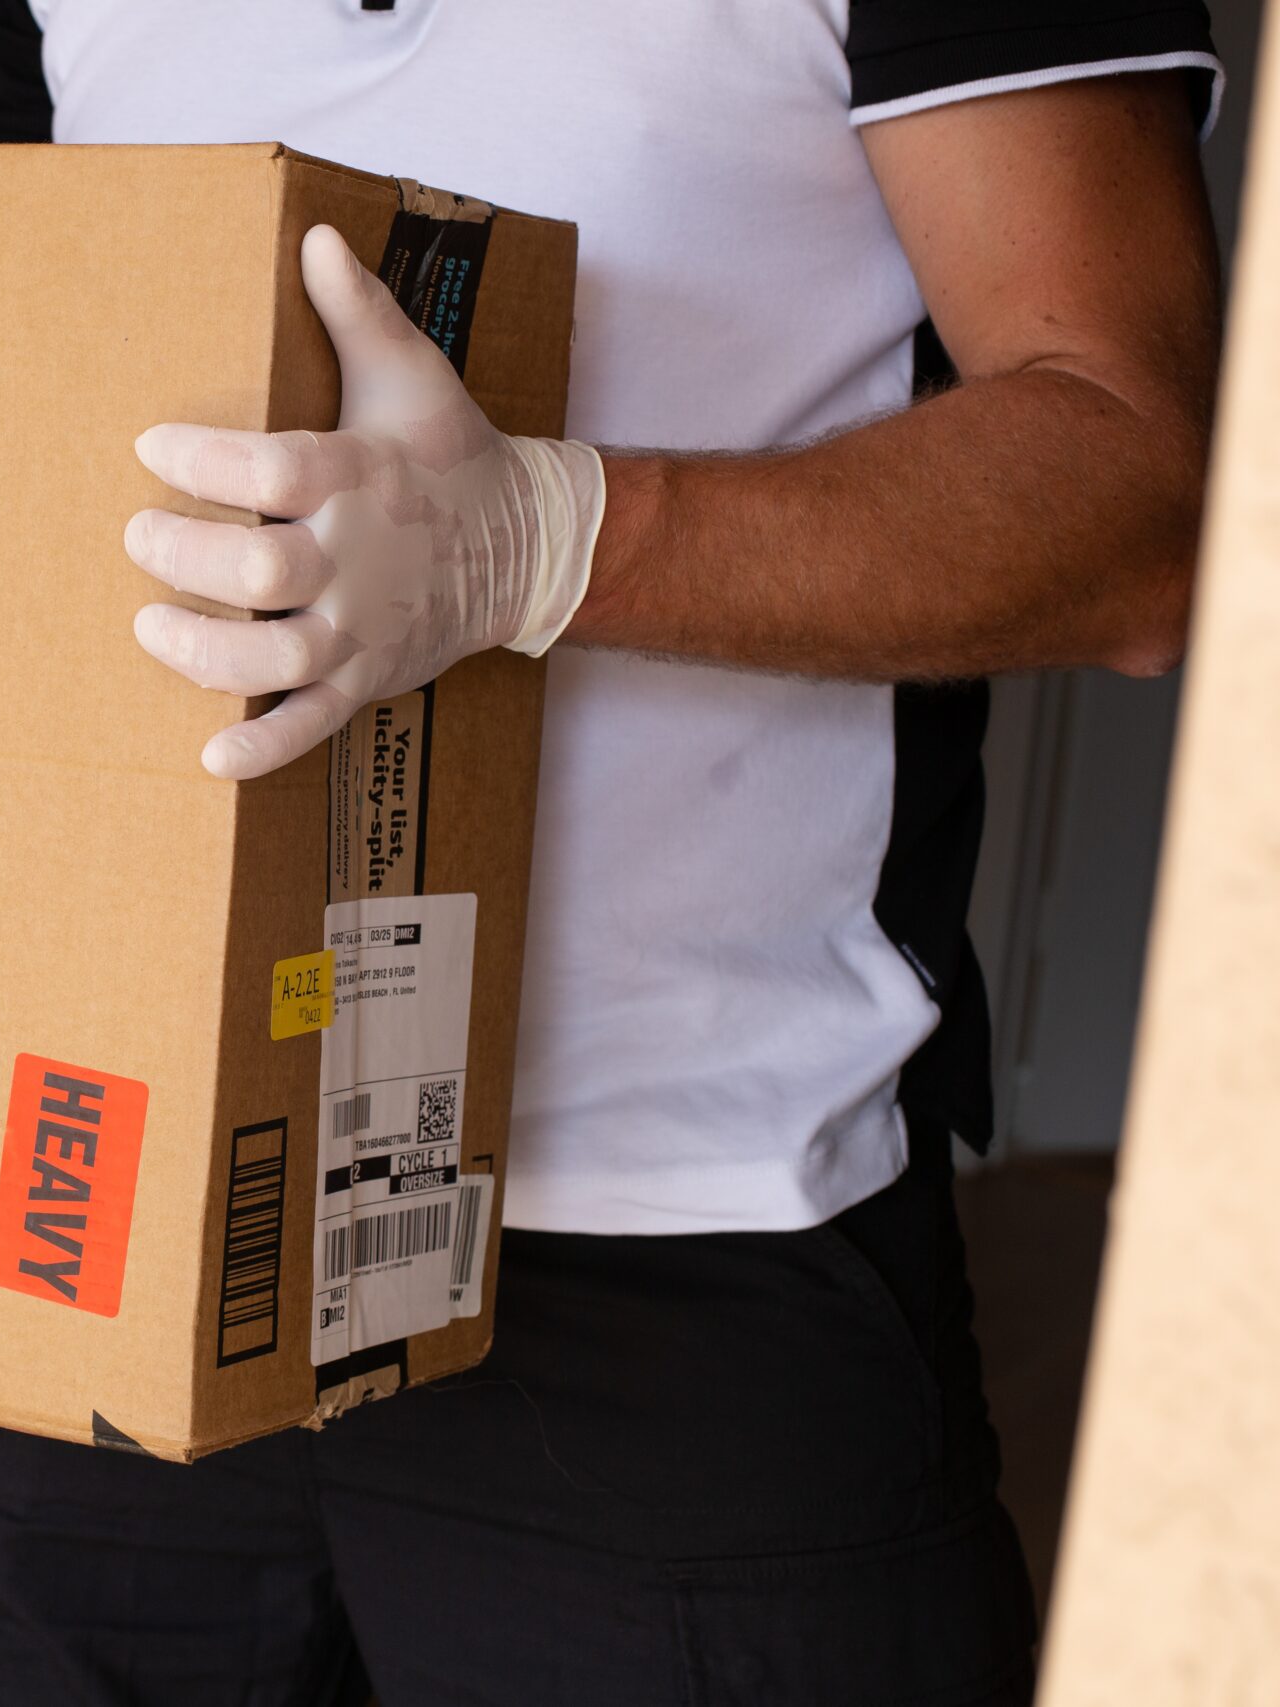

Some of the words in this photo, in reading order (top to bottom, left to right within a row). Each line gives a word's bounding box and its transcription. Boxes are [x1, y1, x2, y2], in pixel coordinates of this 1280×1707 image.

[430, 255, 443, 286] Now
[452, 258, 470, 304] Free
[430, 257, 457, 339] grocery
[392, 727, 411, 801] Your
[335, 729, 345, 876] Amazon.com/grocery
[342, 778, 350, 832] grocery
[366, 707, 393, 892] lickity-split
[342, 834, 350, 889] delivery
[385, 809, 408, 868] list,
[370, 928, 391, 942] 03/25
[395, 927, 415, 940] DMI2
[281, 967, 320, 1002] A-2.2E
[359, 969, 371, 981] APT
[372, 968, 387, 980] 2912
[388, 967, 394, 978] 9
[394, 965, 416, 978] FLOOR
[371, 987, 388, 998] BEACH
[398, 1149, 435, 1174] CYCLE
[441, 1148, 448, 1167] 1
[399, 1170, 446, 1193] OVERSIZE
[18, 1071, 106, 1304] HEAVY
